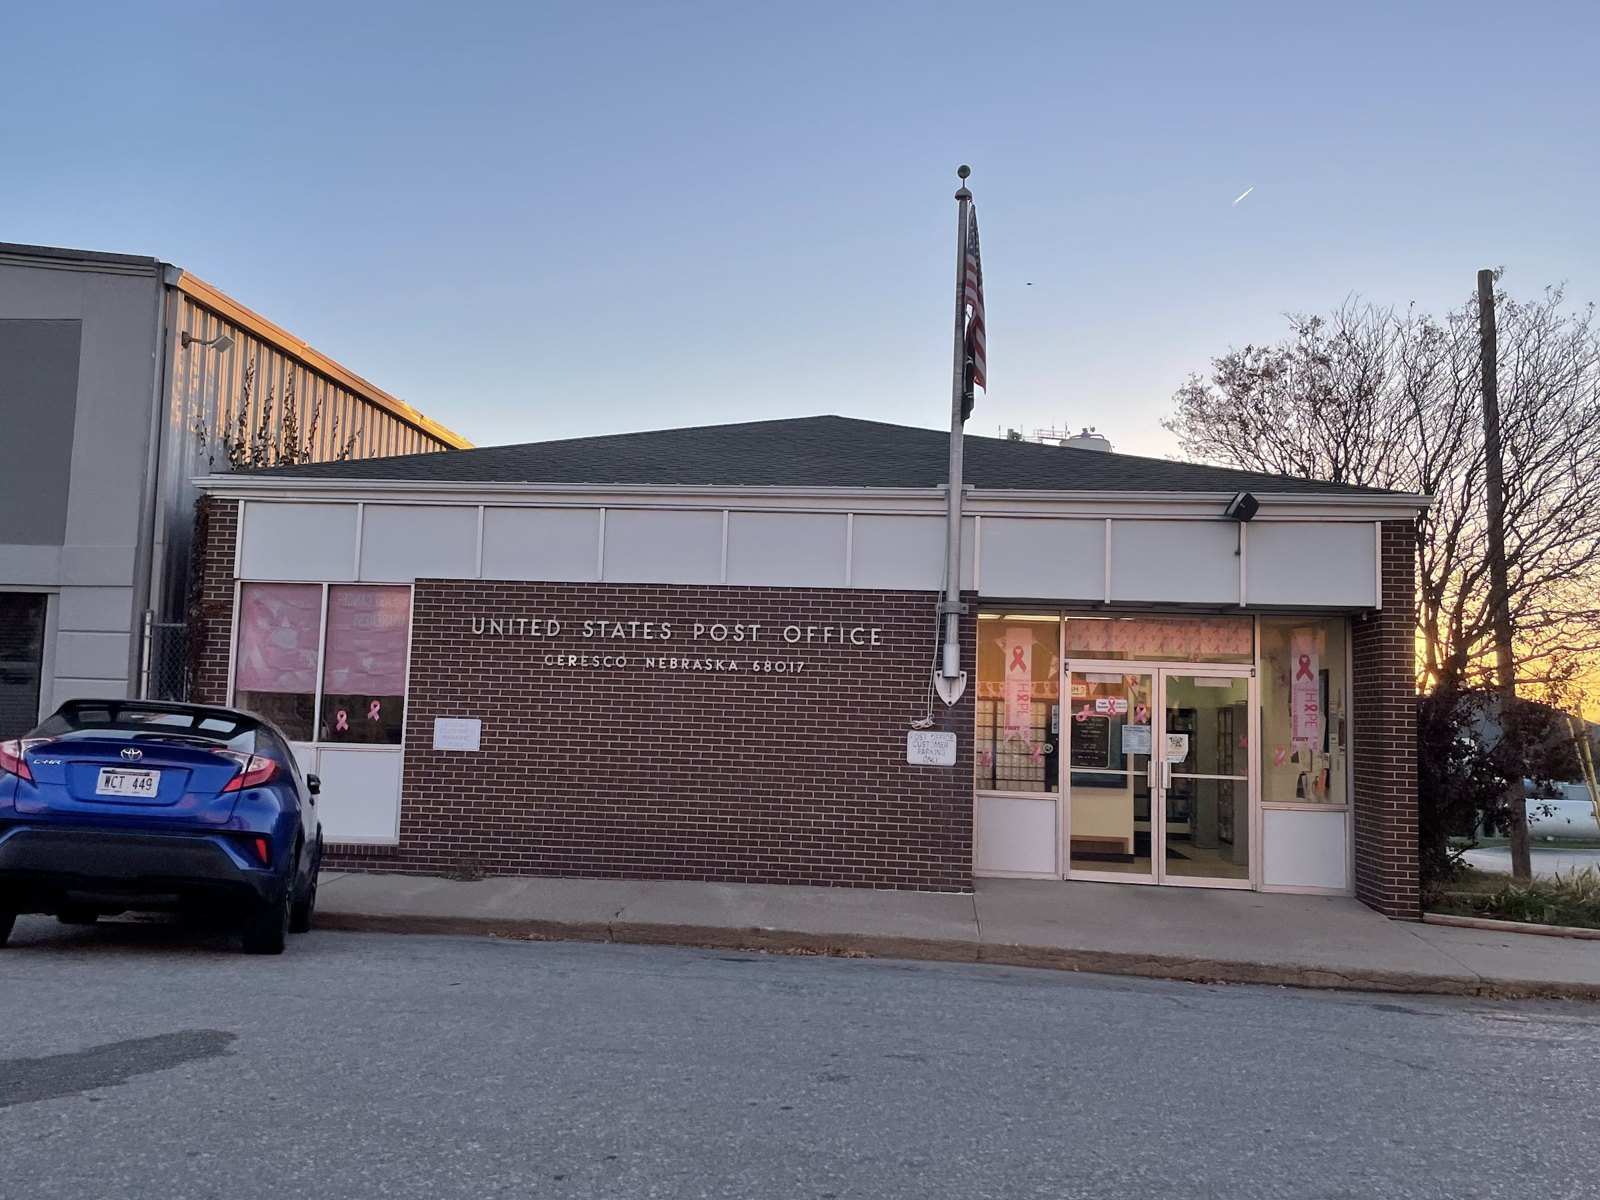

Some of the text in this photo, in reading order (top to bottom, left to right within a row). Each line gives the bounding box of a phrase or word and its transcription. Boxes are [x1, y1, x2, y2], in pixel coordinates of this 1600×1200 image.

[472, 616, 882, 646] UNITED STATES POST OFFICE
[544, 654, 805, 673] CERESCO NEBRASKA 68017
[103, 775, 153, 791] WCT 449
